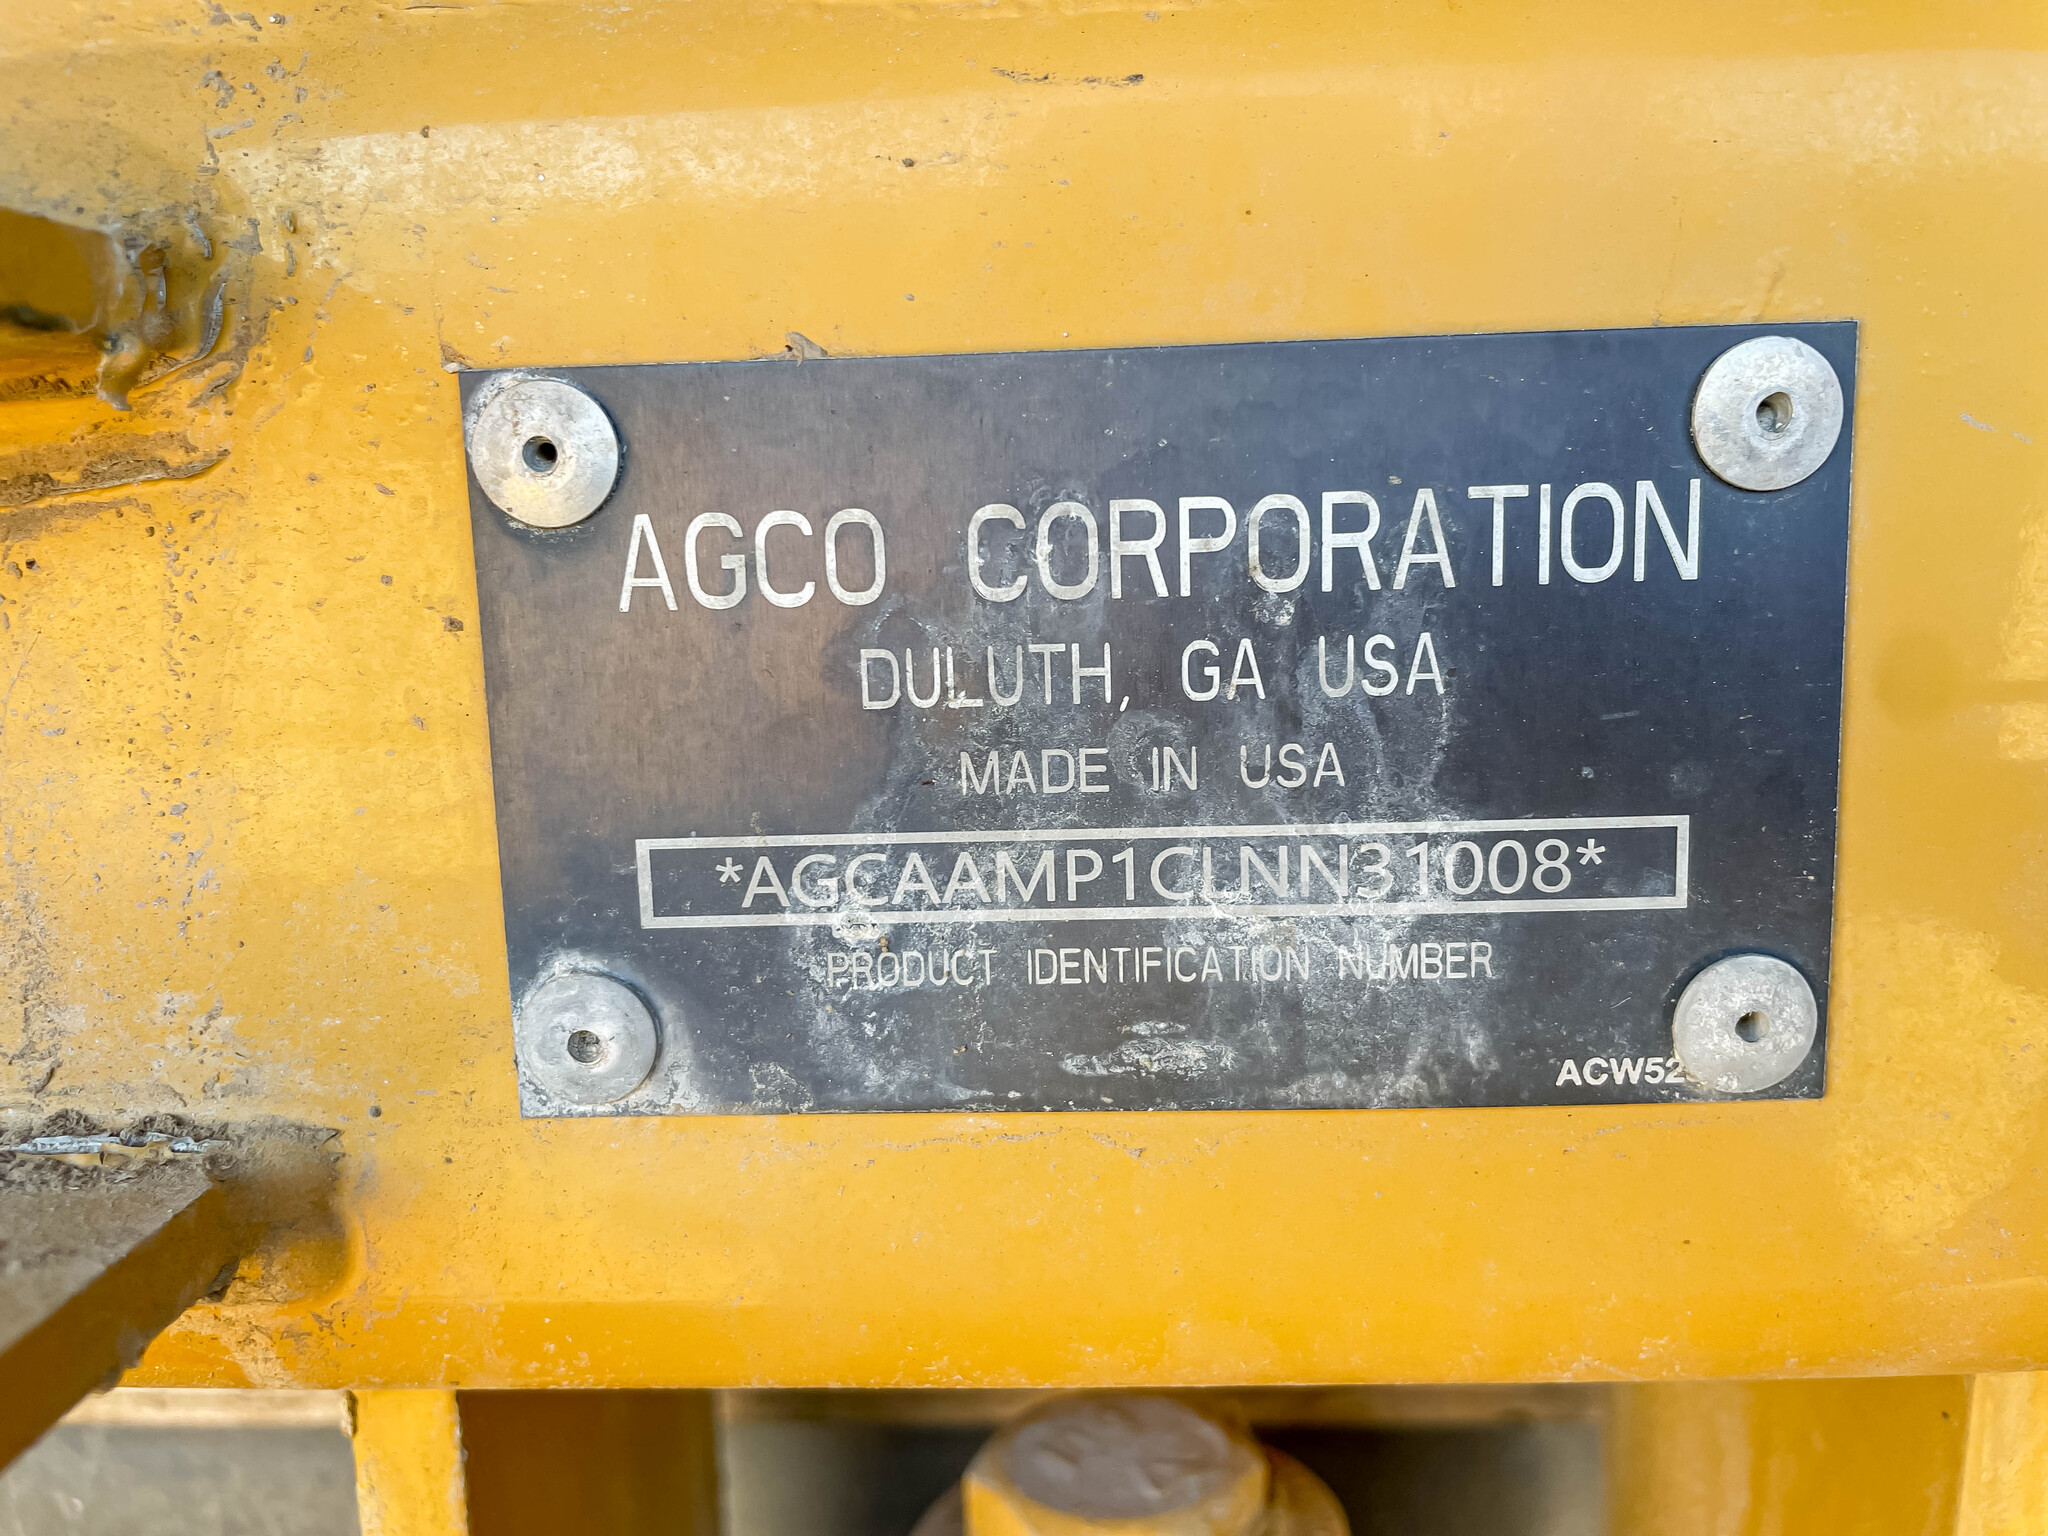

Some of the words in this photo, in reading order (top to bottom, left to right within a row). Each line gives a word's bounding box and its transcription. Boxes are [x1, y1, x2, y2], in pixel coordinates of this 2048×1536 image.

[618, 507, 887, 613] AGCO
[966, 478, 1702, 603] CORPORATION
[859, 641, 1130, 712] DULUTH,
[1181, 637, 1266, 702] GA
[1318, 631, 1445, 698] USA
[960, 747, 1110, 796] MADE
[1152, 745, 1199, 792] IN
[1239, 742, 1346, 789] USA
[825, 948, 998, 990] PRODUCT
[1026, 945, 1310, 985] IDENTIFICATION
[1337, 941, 1494, 981] NUMBER
[1555, 1056, 1697, 1087] ACW52
